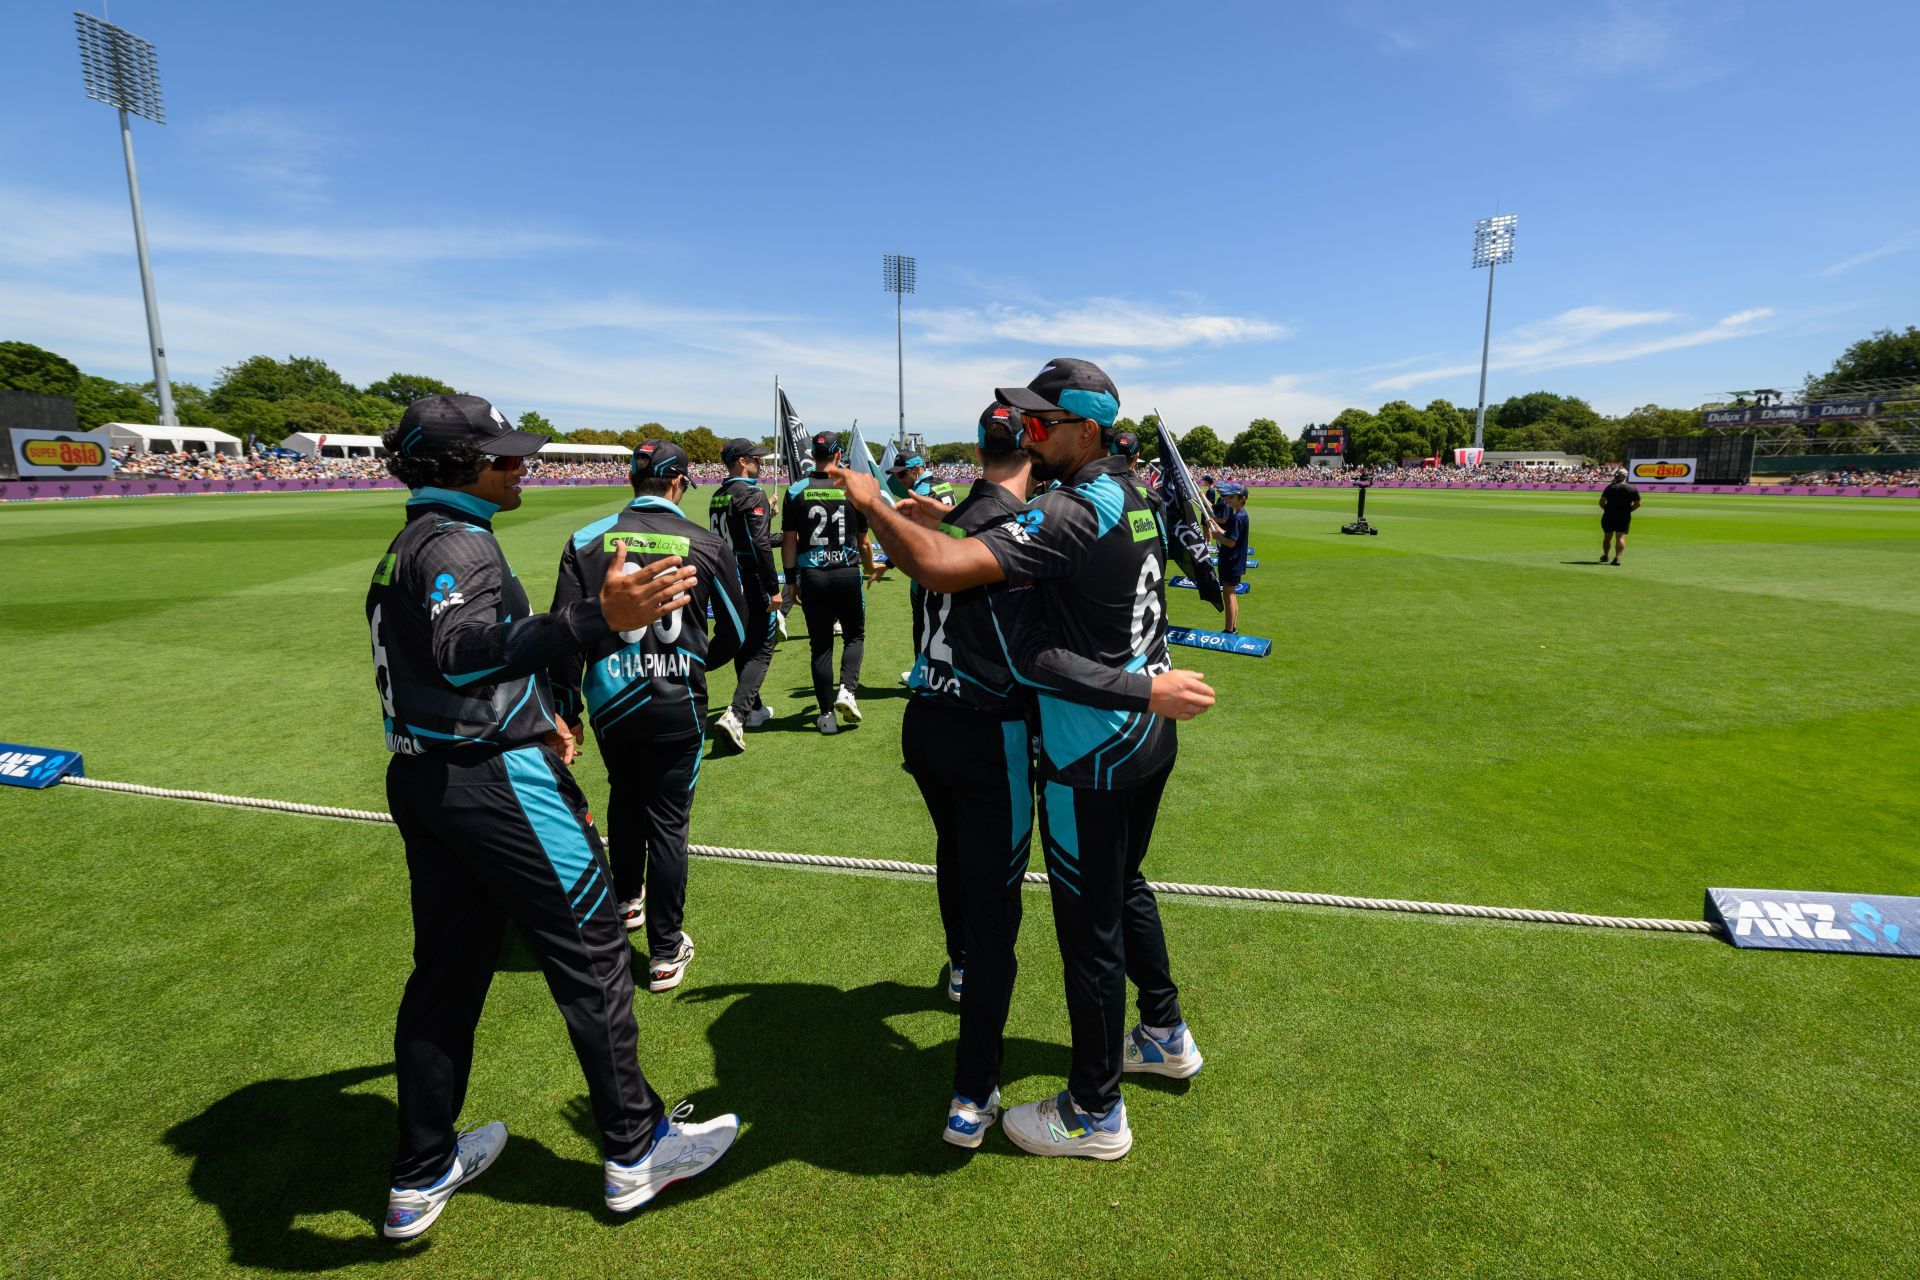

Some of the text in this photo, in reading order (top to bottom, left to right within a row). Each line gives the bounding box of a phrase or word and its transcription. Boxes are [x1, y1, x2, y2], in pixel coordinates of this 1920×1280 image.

[1708, 413, 1740, 423] Dulux
[1761, 409, 1799, 419] Dulux
[1821, 405, 1862, 416] Dulux
[29, 443, 98, 464] SUPER asia
[1656, 464, 1684, 476] asia
[807, 505, 846, 546] 21
[1001, 521, 1031, 544] ANZ
[1133, 517, 1155, 533] Gillette
[810, 550, 845, 562] HENRY
[431, 592, 465, 621] ANZ
[1131, 553, 1162, 657] 6
[1167, 630, 1197, 641] ET'S
[1200, 635, 1226, 646] GO!
[607, 653, 691, 679] CHAPMAN
[1736, 900, 1852, 940] ANZ
